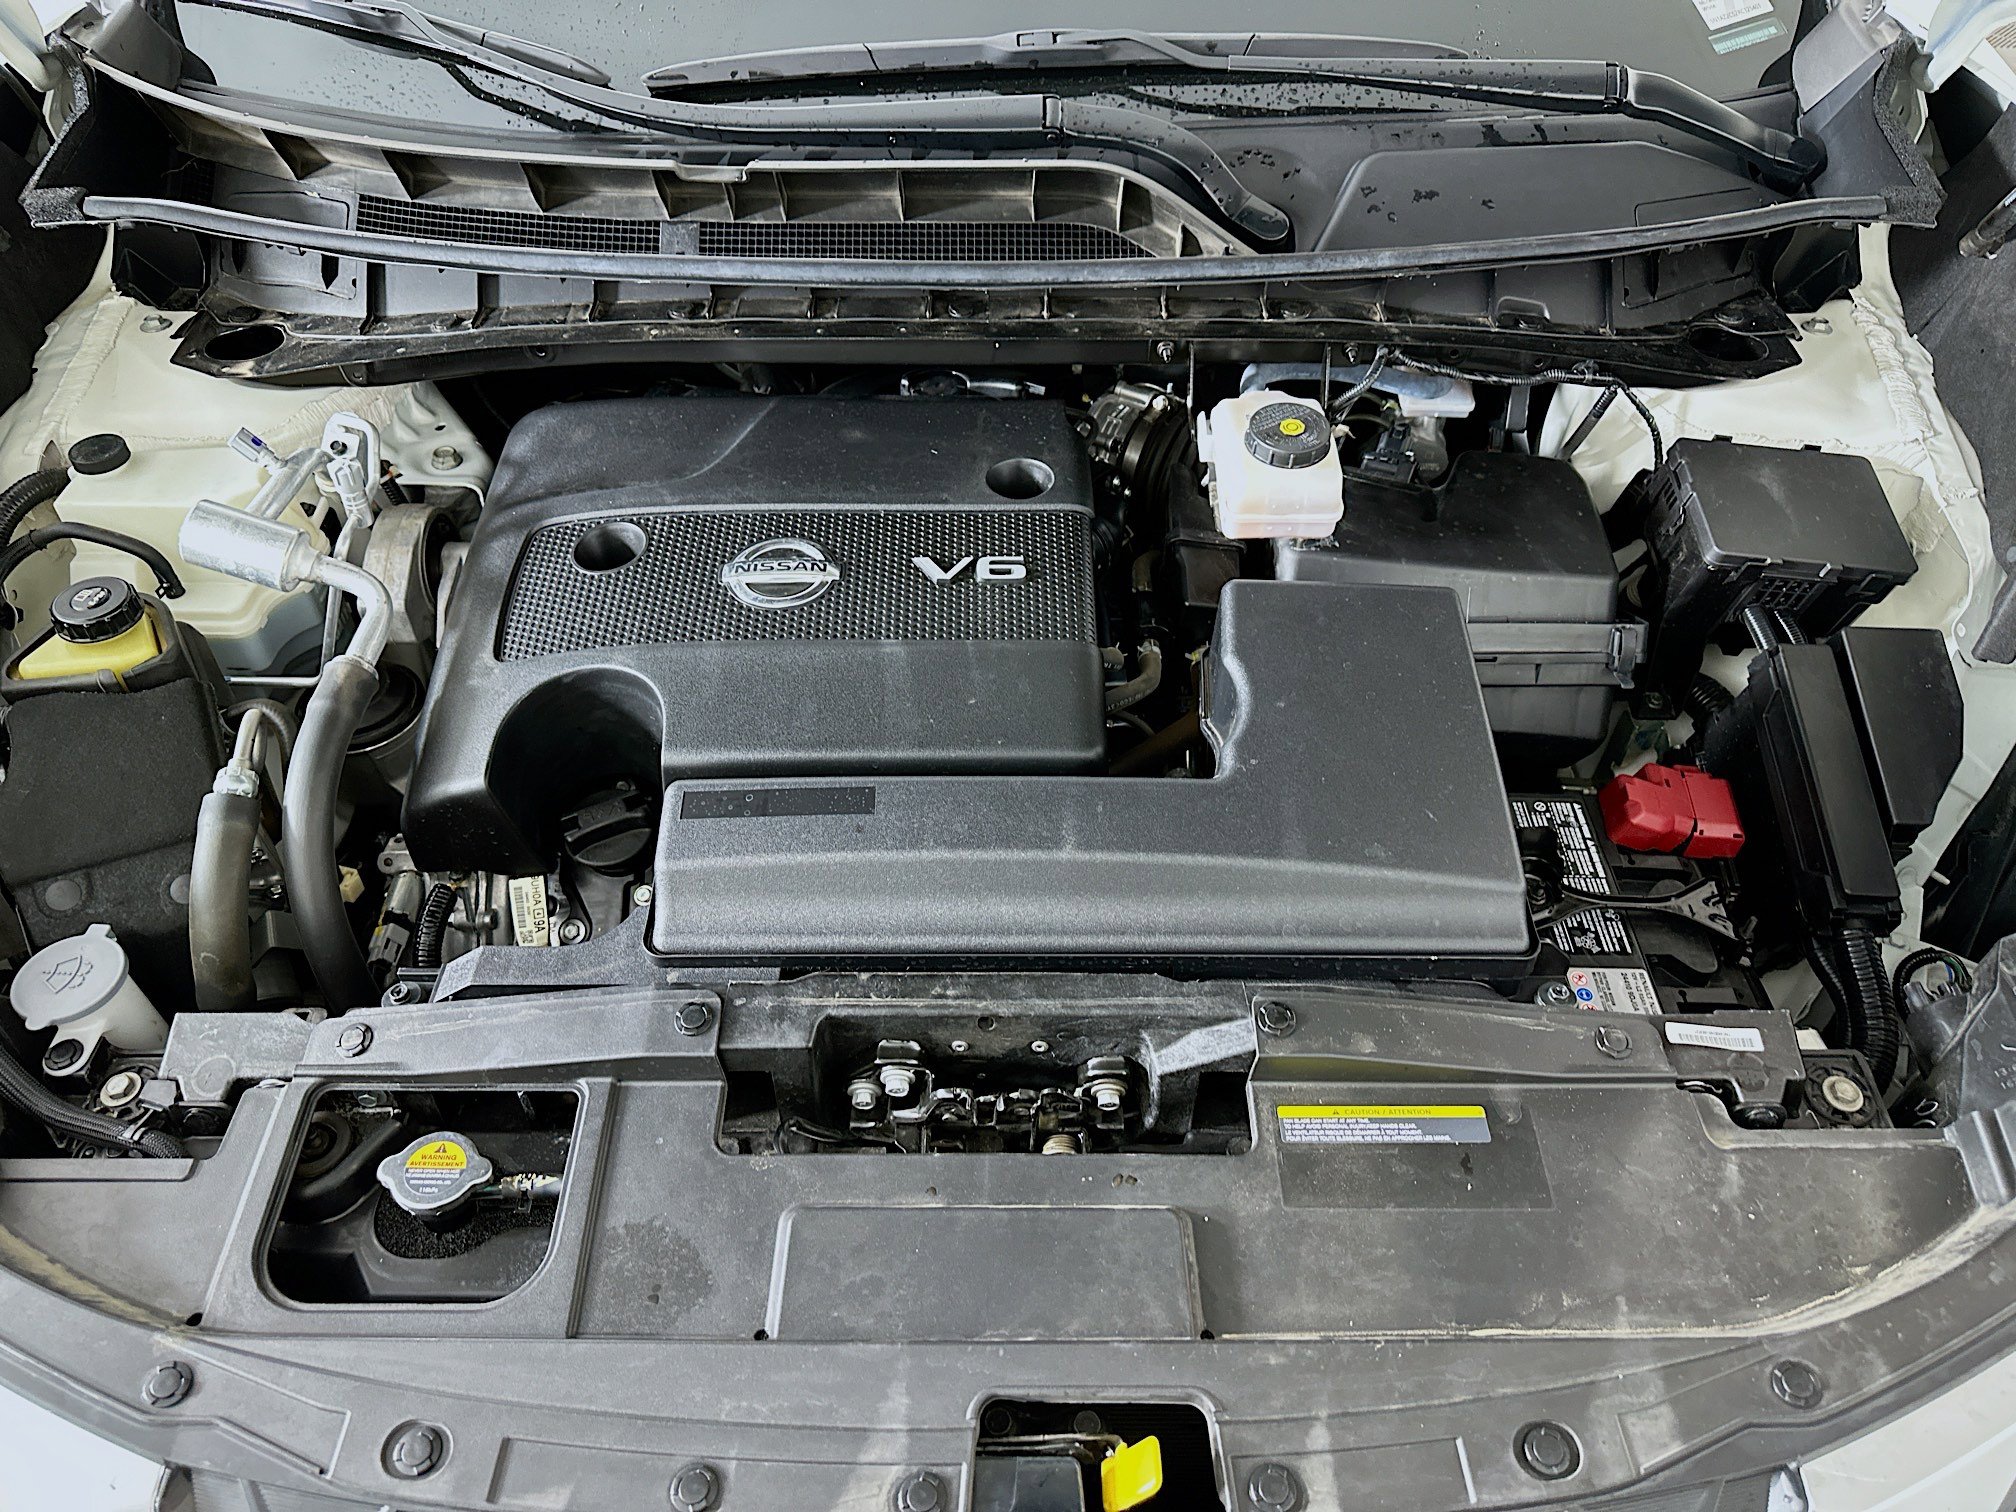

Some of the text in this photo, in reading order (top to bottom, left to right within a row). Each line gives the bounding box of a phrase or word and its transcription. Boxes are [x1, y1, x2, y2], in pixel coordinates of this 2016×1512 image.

[733, 554, 1027, 585] NISSAN V6
[534, 919, 545, 934] 9A
